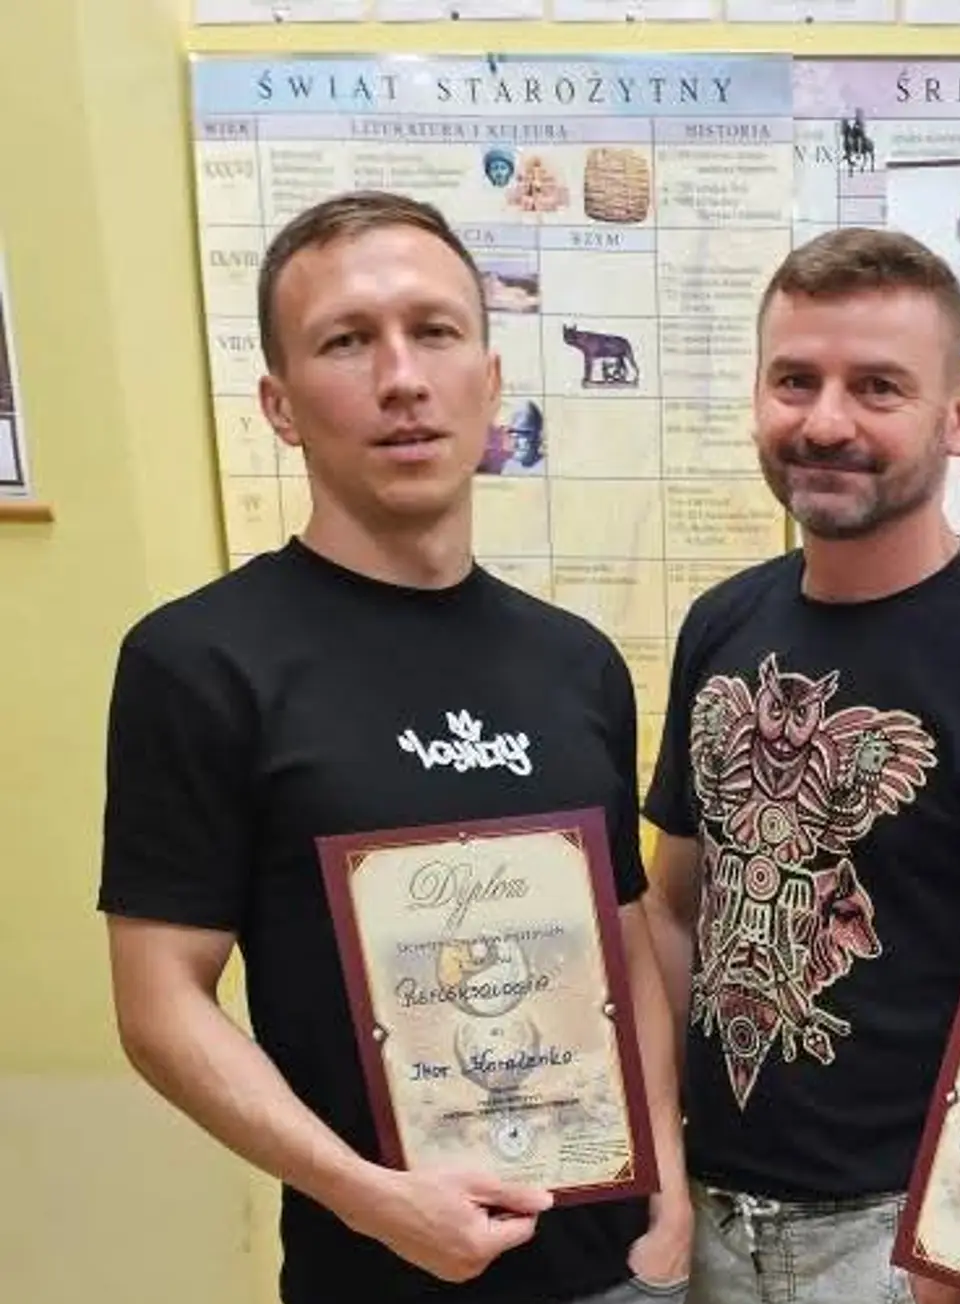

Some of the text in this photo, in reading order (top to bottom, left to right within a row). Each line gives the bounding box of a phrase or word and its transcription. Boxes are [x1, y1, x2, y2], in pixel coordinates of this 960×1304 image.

[257, 71, 735, 102] ŚWIAT STAROŻYTNY
[685, 125, 771, 138] HISTORIA
